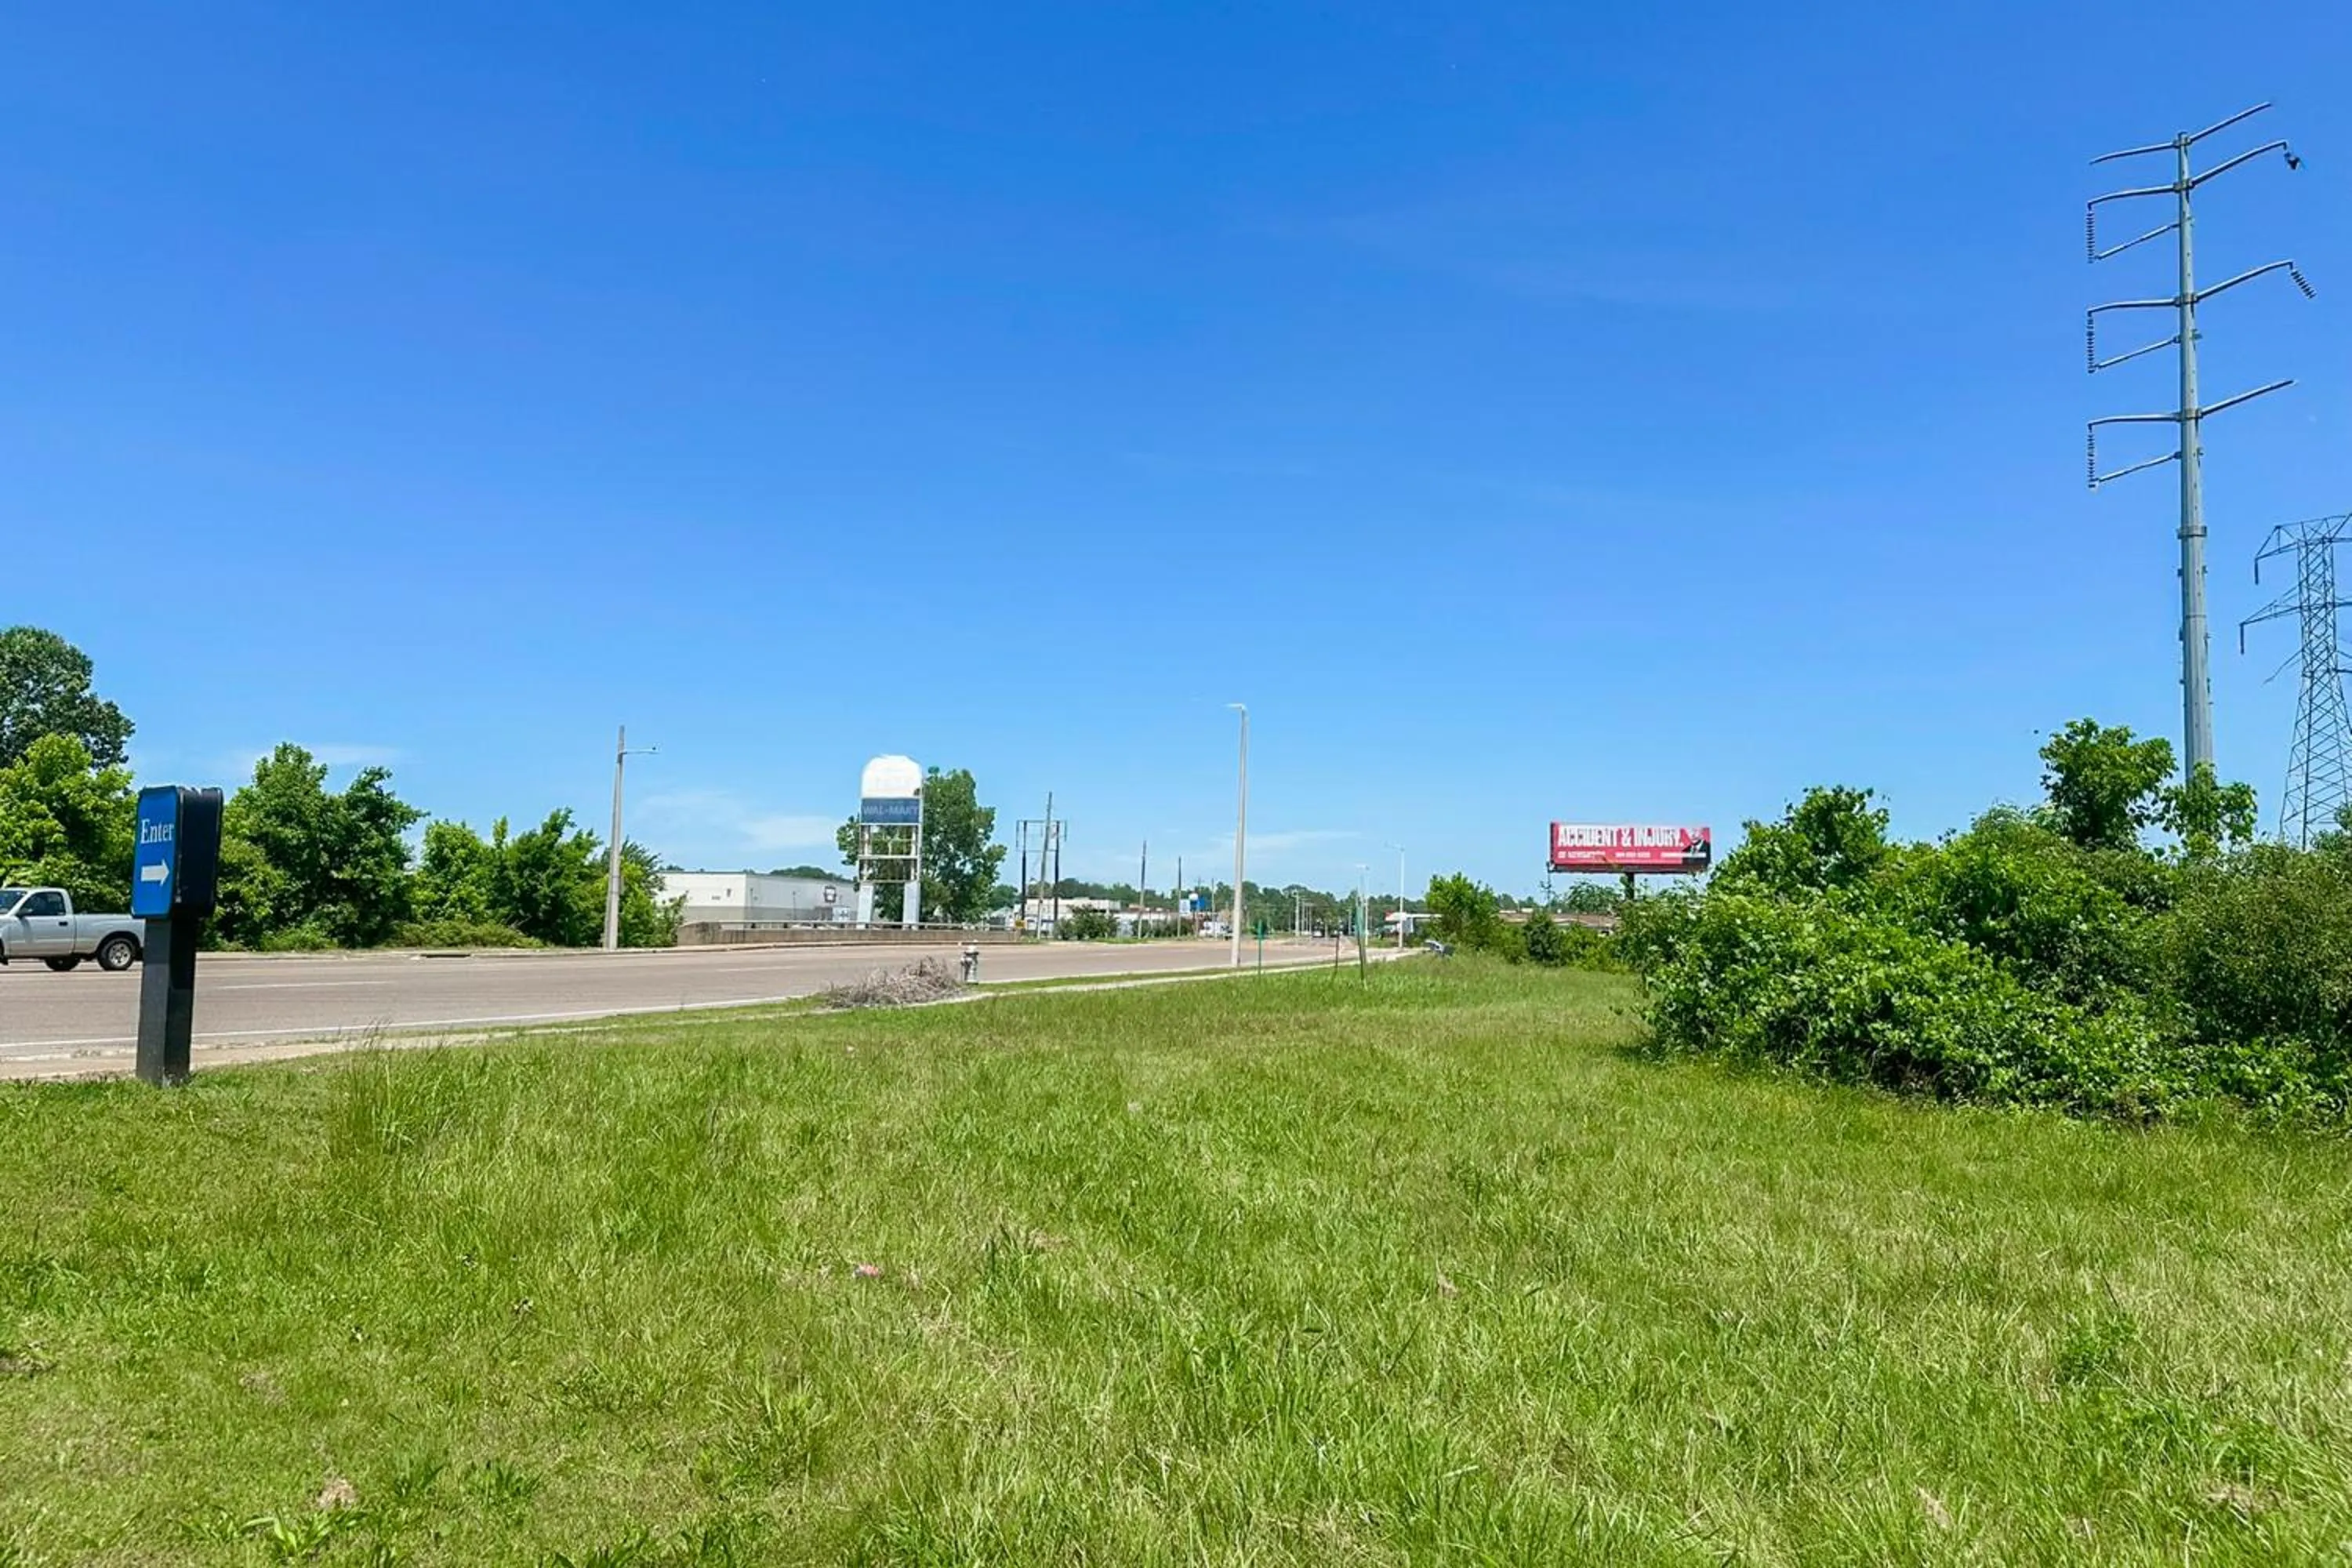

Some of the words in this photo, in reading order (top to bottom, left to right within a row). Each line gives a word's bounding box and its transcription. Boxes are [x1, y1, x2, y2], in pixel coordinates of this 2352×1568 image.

[140, 818, 174, 844] Enter
[1558, 826, 1617, 847] ACCIDENT
[1621, 826, 1632, 847] &
